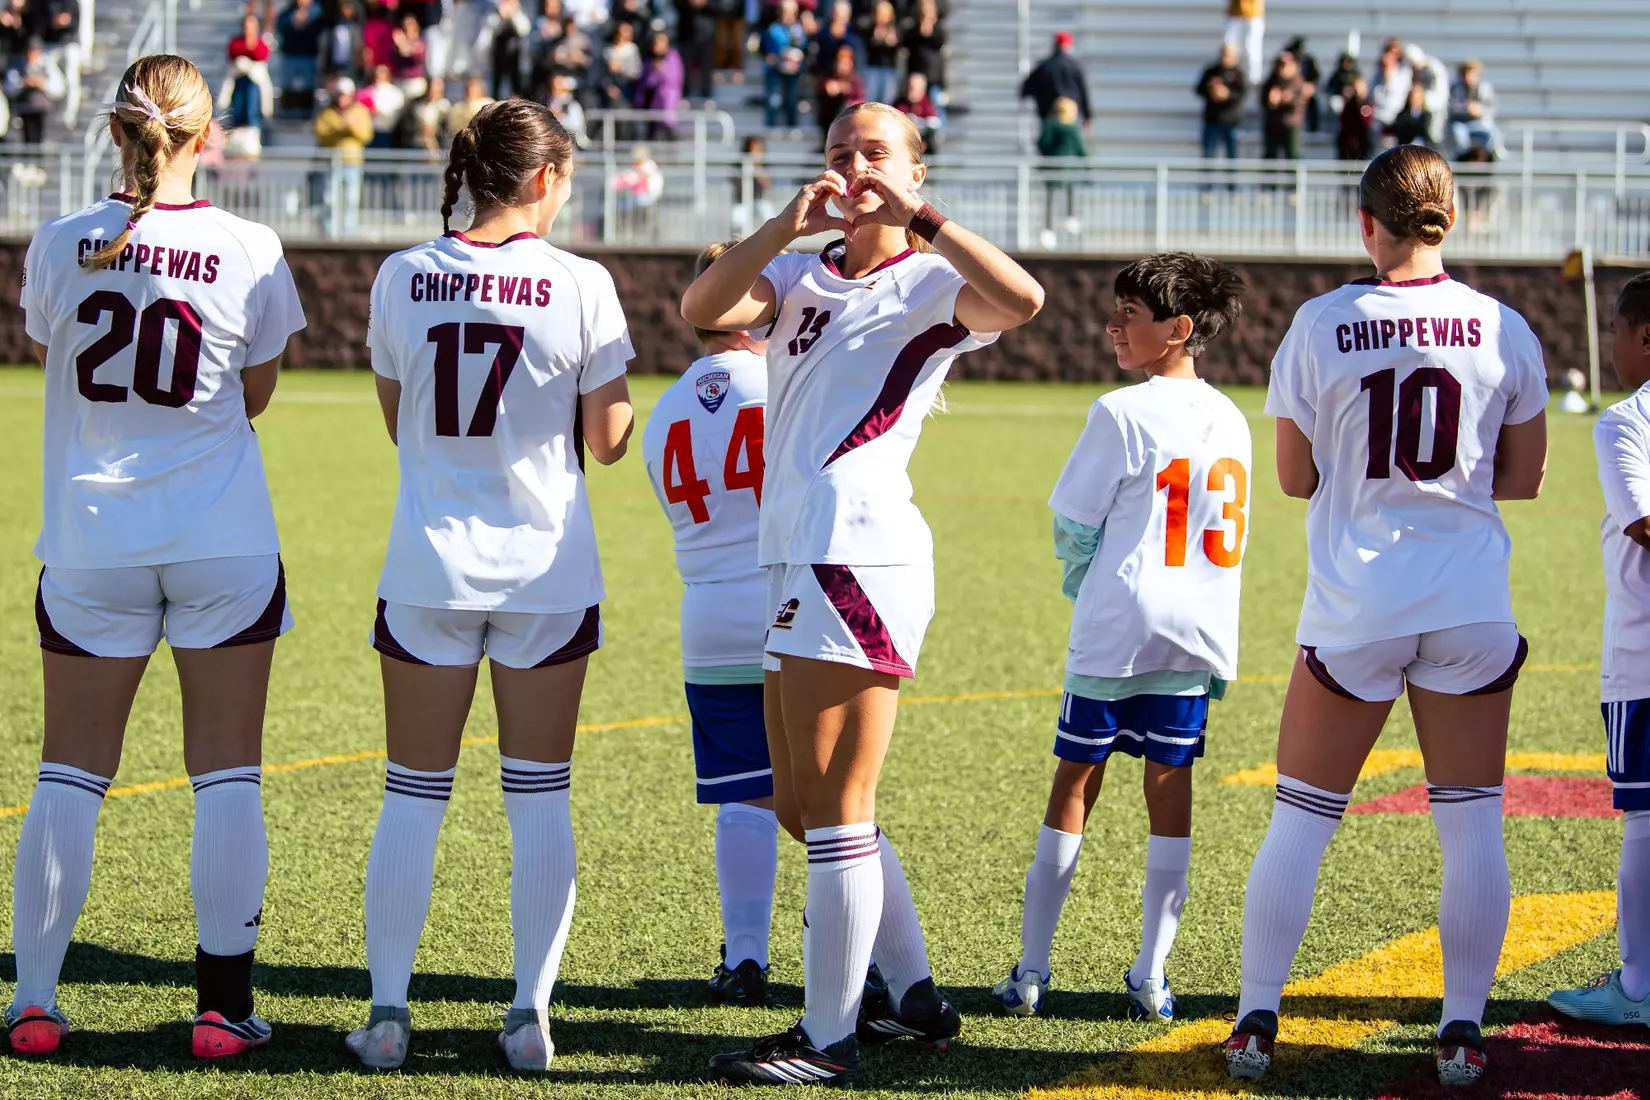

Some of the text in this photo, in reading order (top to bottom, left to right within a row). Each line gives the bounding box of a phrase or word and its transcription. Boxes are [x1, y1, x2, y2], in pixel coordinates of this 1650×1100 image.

[411, 272, 552, 308] CHIPPEWAS
[1336, 317, 1482, 354] CHIPPEWAS
[76, 290, 203, 409] 20
[427, 322, 525, 437] 17
[697, 373, 729, 385] MICHIGAN
[663, 407, 766, 524] 44
[1360, 367, 1462, 482] 10
[1157, 457, 1247, 569] 13
[1623, 1011, 1640, 1020] DSG
